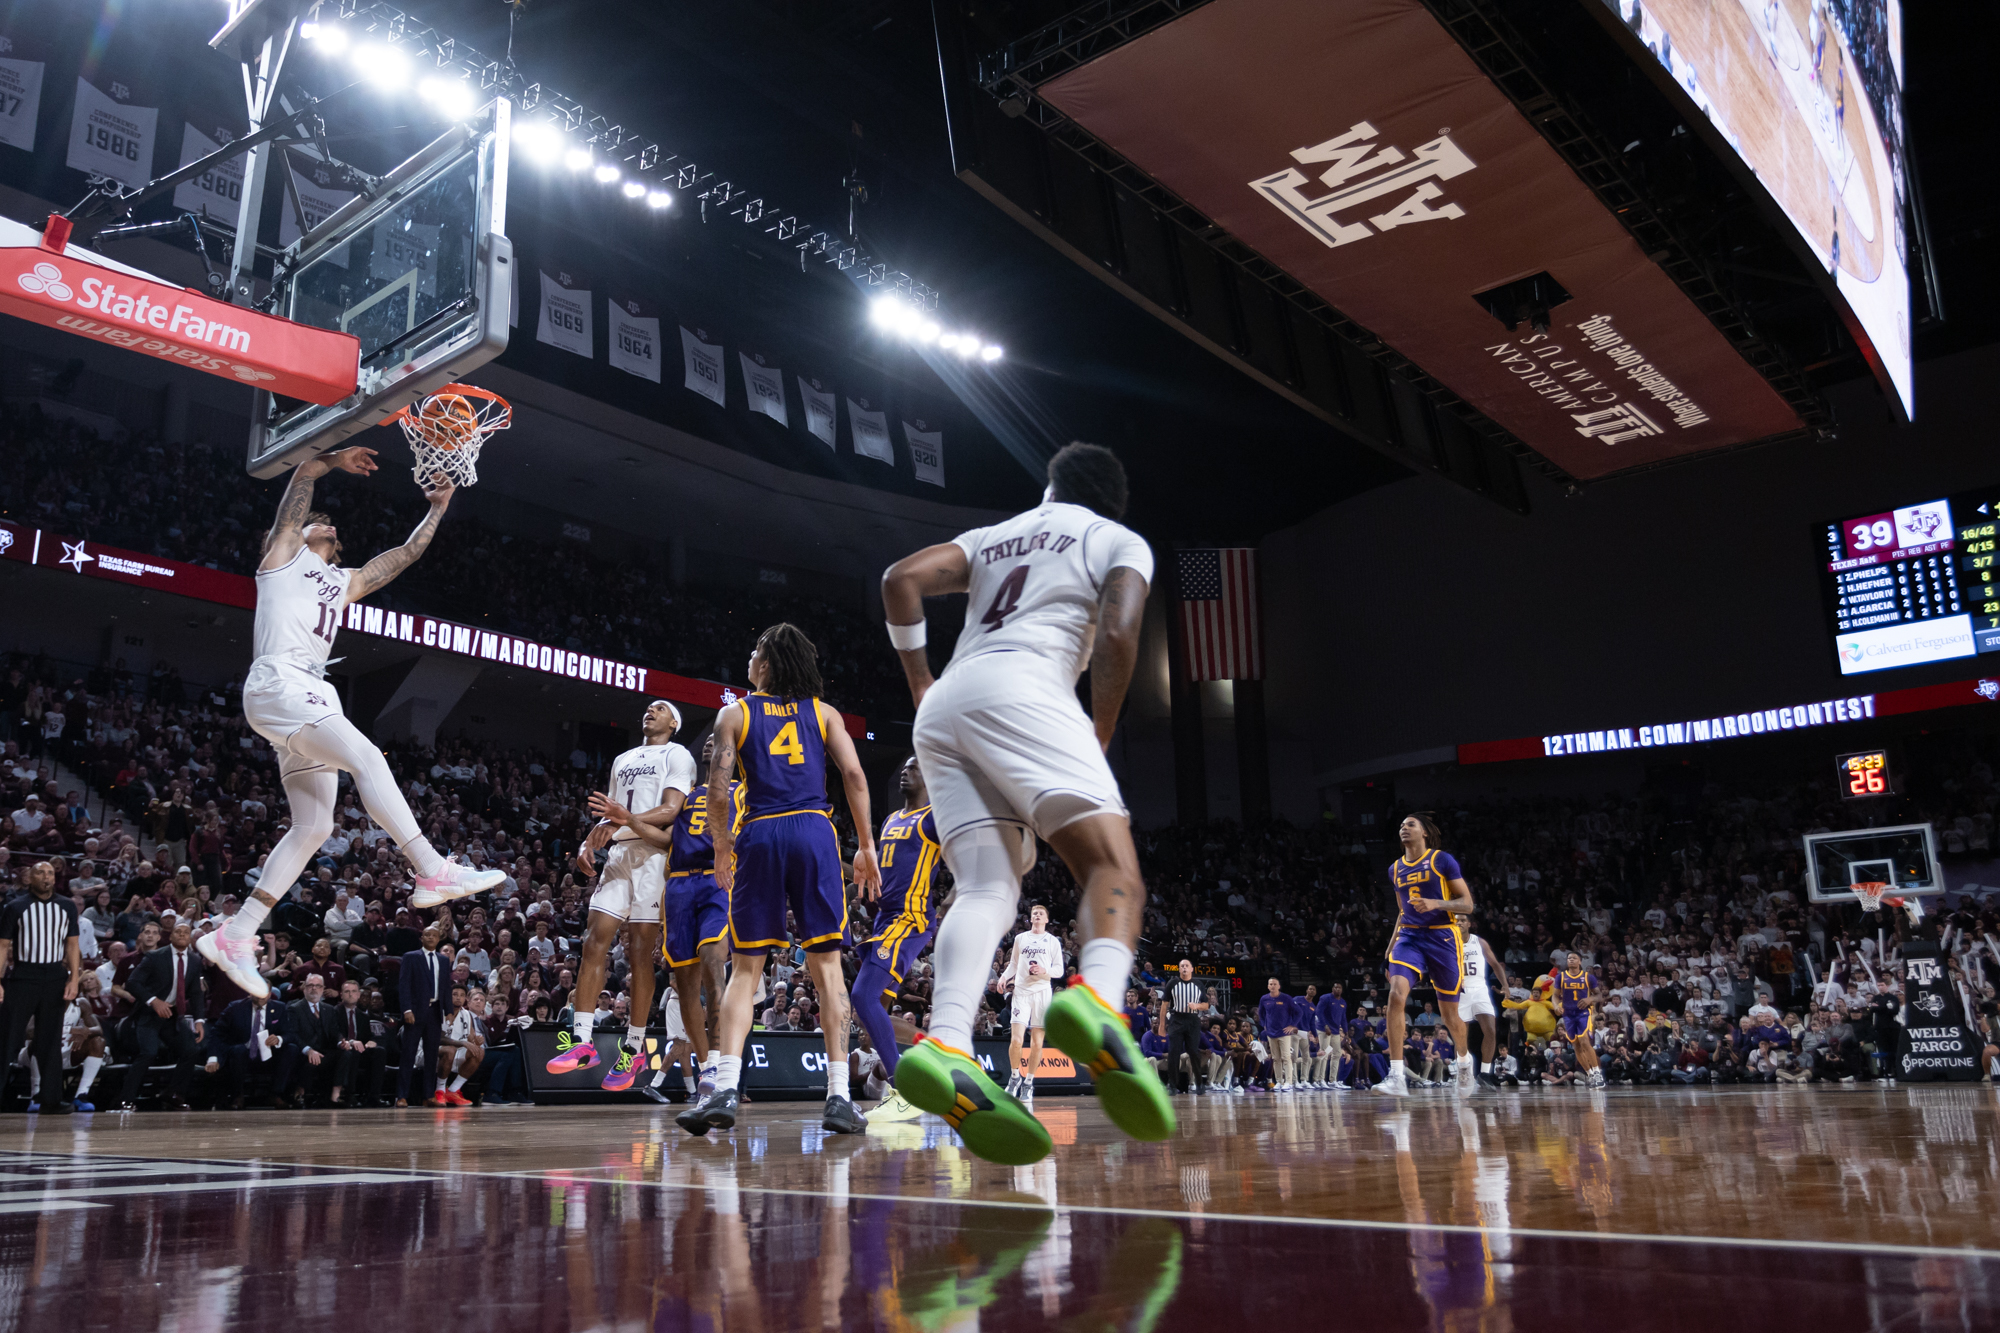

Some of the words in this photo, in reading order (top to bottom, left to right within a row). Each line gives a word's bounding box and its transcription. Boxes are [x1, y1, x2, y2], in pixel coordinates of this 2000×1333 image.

[89, 114, 142, 139] CHAMPIONSHIP
[94, 108, 139, 131] CONFERENCE
[85, 123, 140, 162] 1986
[547, 306, 584, 334] 1969
[617, 333, 653, 360] 1964
[1606, 344, 1646, 372] love
[692, 358, 718, 384] 1951
[1483, 342, 1588, 410] AMERICAN
[1519, 333, 1618, 404] CAMPUS
[1626, 363, 1682, 401] students
[1666, 396, 1711, 429] Where
[914, 449, 937, 468] 920
[1827, 531, 1837, 543] 3
[1851, 520, 1894, 551] 39
[1961, 525, 1995, 540] 16/42
[980, 531, 1051, 566] TAYLOR
[1049, 534, 1078, 554] IV
[1830, 551, 1840, 562] 1
[1892, 550, 1905, 559] PTS
[1908, 547, 1921, 556] REB
[1924, 544, 1936, 553] AST
[1940, 542, 1949, 550] PF
[1966, 540, 1995, 554] 4/15
[98, 554, 123, 567] TEXAS
[123, 559, 144, 570] FARM
[144, 564, 175, 577] BUREAU
[98, 561, 142, 577] INSURANCE
[1831, 558, 1857, 571] TEXAS
[1836, 575, 1843, 583] 1
[1845, 566, 1889, 582] Z.PHELPS
[1897, 563, 1905, 572] 9
[1912, 561, 1921, 570] 4
[1928, 558, 1936, 567] 2
[1942, 555, 1951, 564] 0
[1972, 555, 1994, 568] 3/7
[1837, 586, 1845, 595] 2
[1847, 577, 1893, 593] H.HEFNER
[1898, 575, 1906, 584] 0
[1914, 573, 1922, 582] 2
[1930, 570, 1938, 579] 0
[1945, 567, 1953, 576] 2
[1981, 571, 1991, 582] 8
[980, 564, 1031, 634] 4
[1839, 597, 1846, 606] 4
[1848, 590, 1885, 604] W.TAYLOR
[1885, 589, 1894, 598] IV
[1900, 587, 1908, 596] 8
[1917, 584, 1925, 593] 3
[1932, 582, 1940, 590] 1
[1947, 579, 1955, 588] 1
[1984, 587, 1994, 597] 5
[1836, 609, 1848, 618] 11
[1850, 601, 1894, 616] A.GARCIA
[1902, 599, 1910, 608] 2
[1918, 596, 1927, 605] 4
[1934, 593, 1942, 602] 0
[1949, 590, 1957, 599] 0
[1983, 601, 1999, 613] 23
[312, 601, 337, 645] 11
[1838, 620, 1850, 630] 15
[1852, 613, 1891, 627] H.COLEMAN
[1891, 611, 1899, 621] III
[1904, 610, 1913, 619] 4
[1921, 608, 1929, 617] 2
[1936, 605, 1944, 614] 1
[1951, 602, 1959, 611] 0
[1989, 617, 1999, 628] 7
[1866, 640, 1912, 657] Calvetti
[1914, 633, 1971, 651] Ferguson
[763, 701, 799, 717] BAILEY
[1541, 694, 1875, 757] 12THMAN.COM/MAROONCONTEST
[769, 721, 805, 765] 4
[1847, 753, 1885, 771] 15:23
[616, 763, 657, 786] Aggies
[1849, 767, 1885, 795] 26
[626, 788, 635, 815] 1
[683, 795, 709, 811] LS
[688, 811, 708, 836] 5
[880, 826, 913, 842] LSU
[880, 842, 896, 868] 11
[1397, 870, 1430, 888] LSU
[1409, 885, 1421, 905] 6
[1021, 945, 1047, 959] Aggies
[1194, 965, 1217, 976] 15:23
[1226, 966, 1236, 975] LSU
[1463, 961, 1477, 976] 15
[1231, 977, 1243, 989] 38
[1564, 982, 1585, 990] LSU
[1572, 990, 1579, 1001] 1
[1907, 1026, 1960, 1039] WELLS
[1911, 1040, 1963, 1053] FARGO
[1020, 1057, 1047, 1068] BK
[1047, 1058, 1070, 1067] NOW
